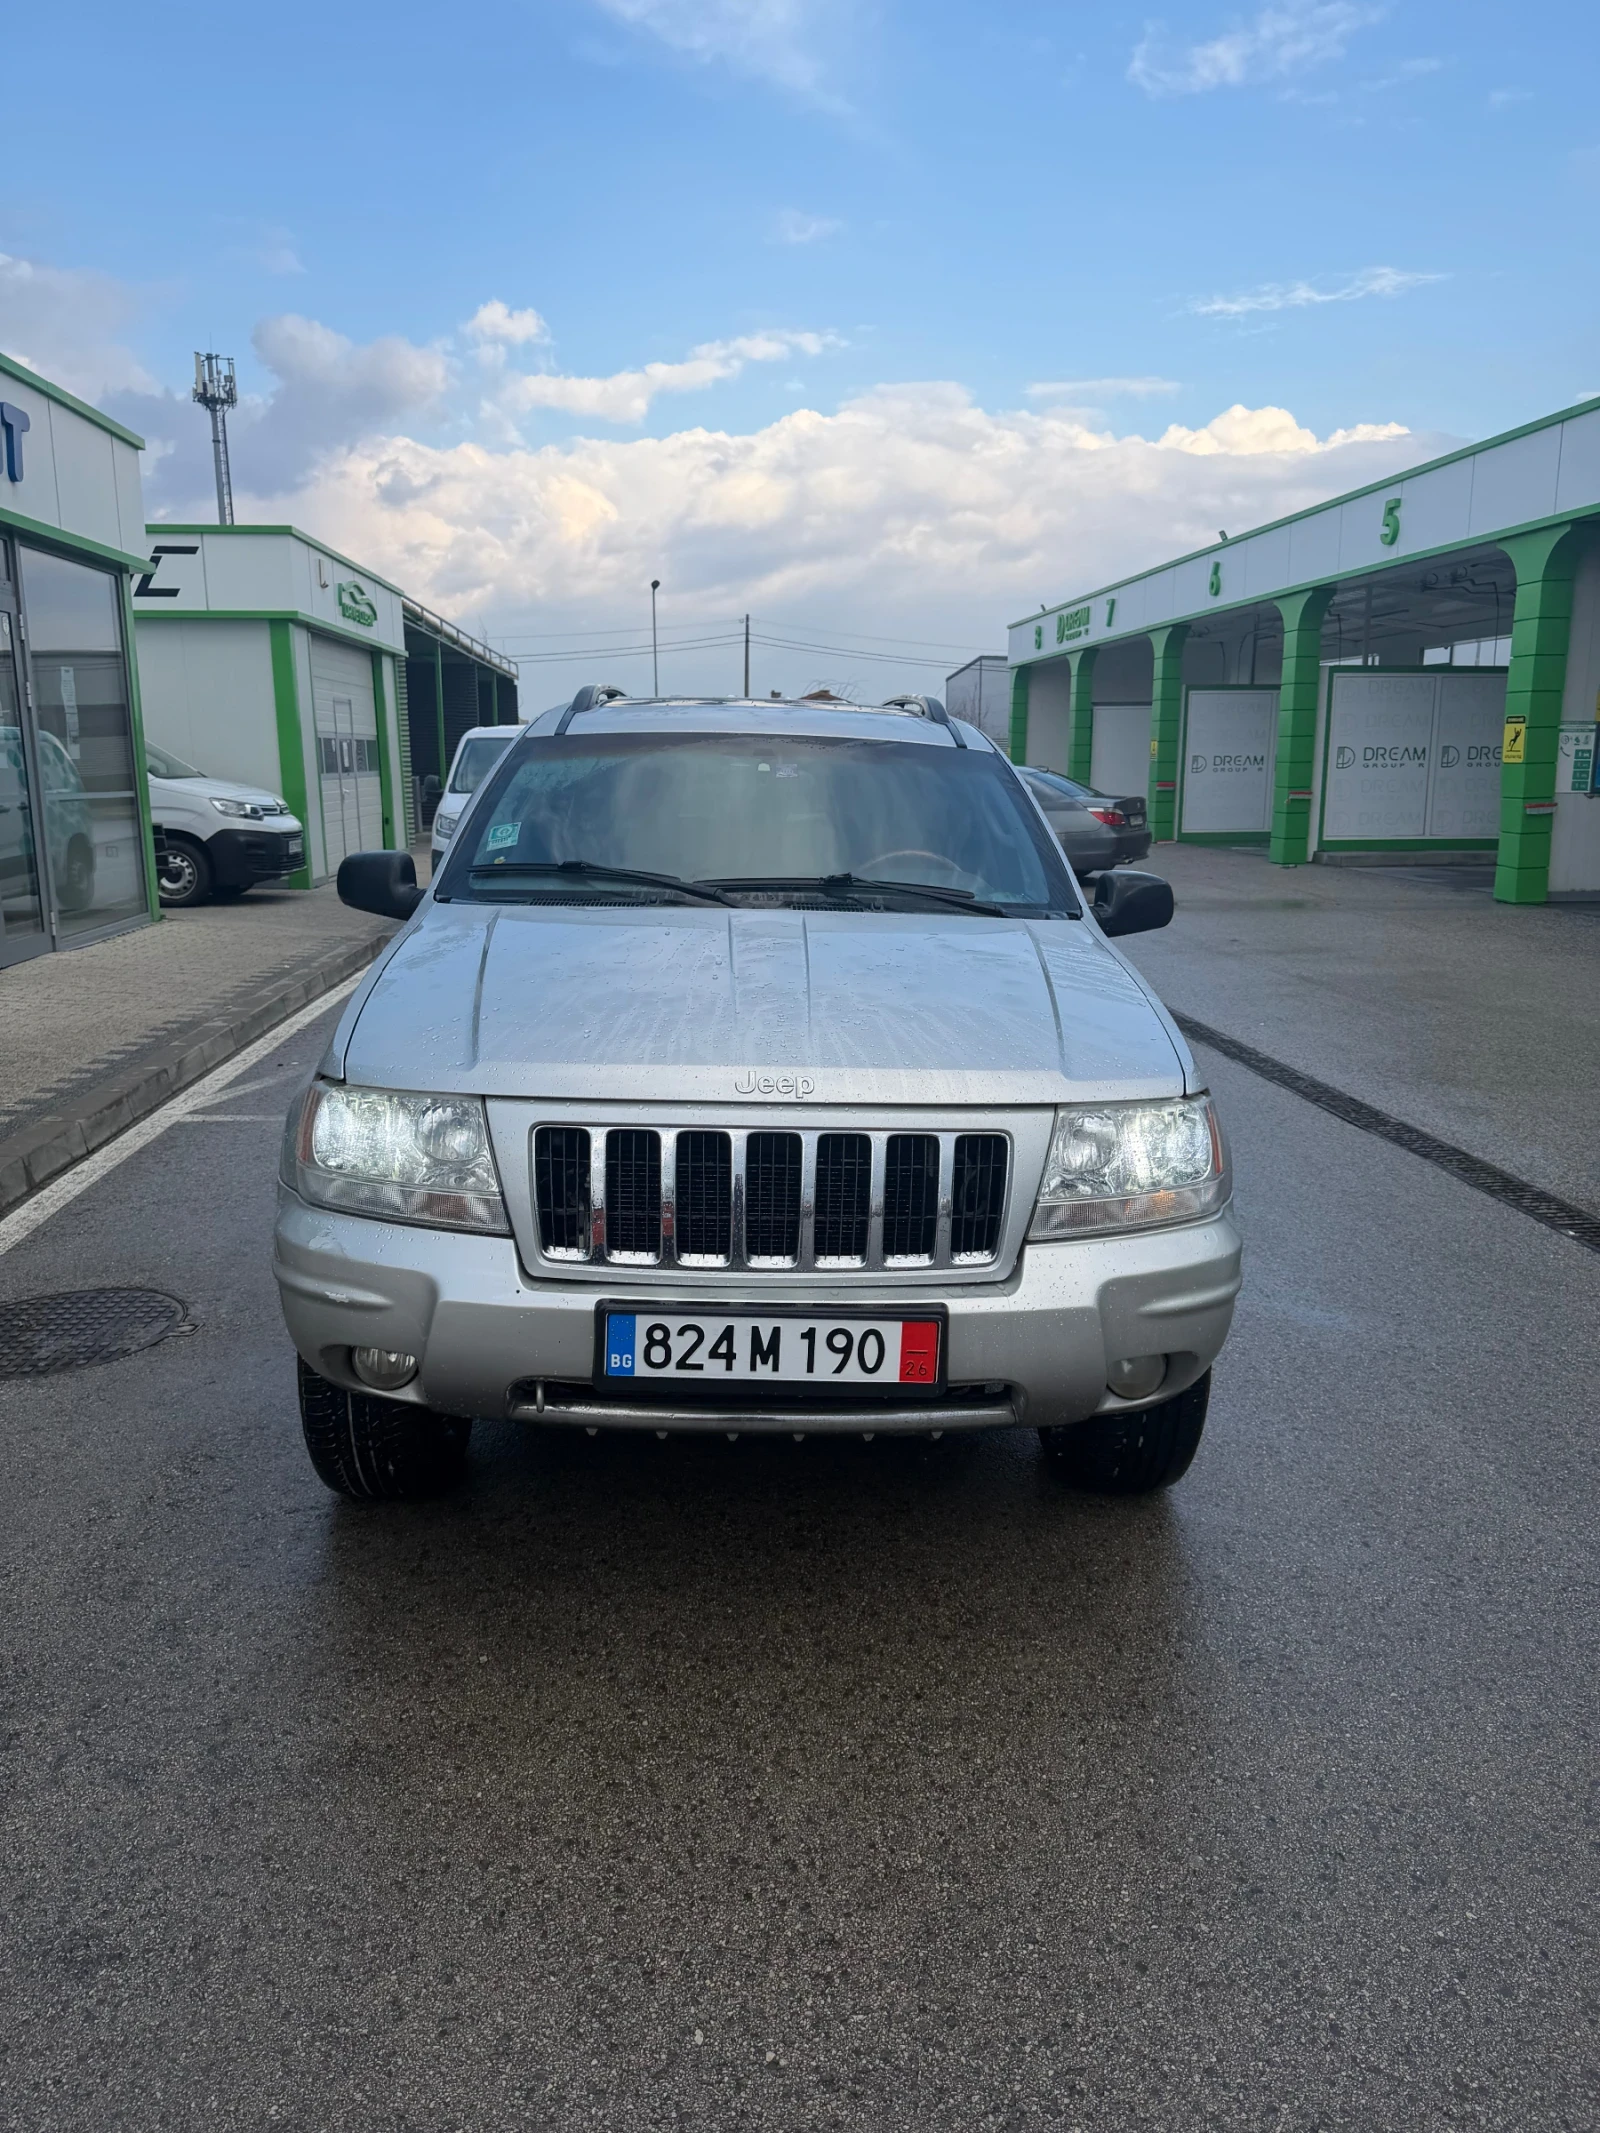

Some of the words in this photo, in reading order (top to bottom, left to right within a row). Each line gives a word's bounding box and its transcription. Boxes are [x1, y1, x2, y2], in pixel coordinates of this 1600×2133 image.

[1379, 497, 1401, 546] 5
[1209, 560, 1221, 596] 6
[1106, 598, 1116, 628] 7
[1213, 755, 1265, 767] DREAM
[1363, 746, 1427, 762] DREAM
[1467, 745, 1503, 761] DRE
[735, 1070, 815, 1098] Jeep
[643, 1323, 737, 1371] 824
[750, 1325, 782, 1373] M
[800, 1326, 886, 1375] 190
[610, 1353, 633, 1369] BG
[905, 1360, 928, 1377] 26
